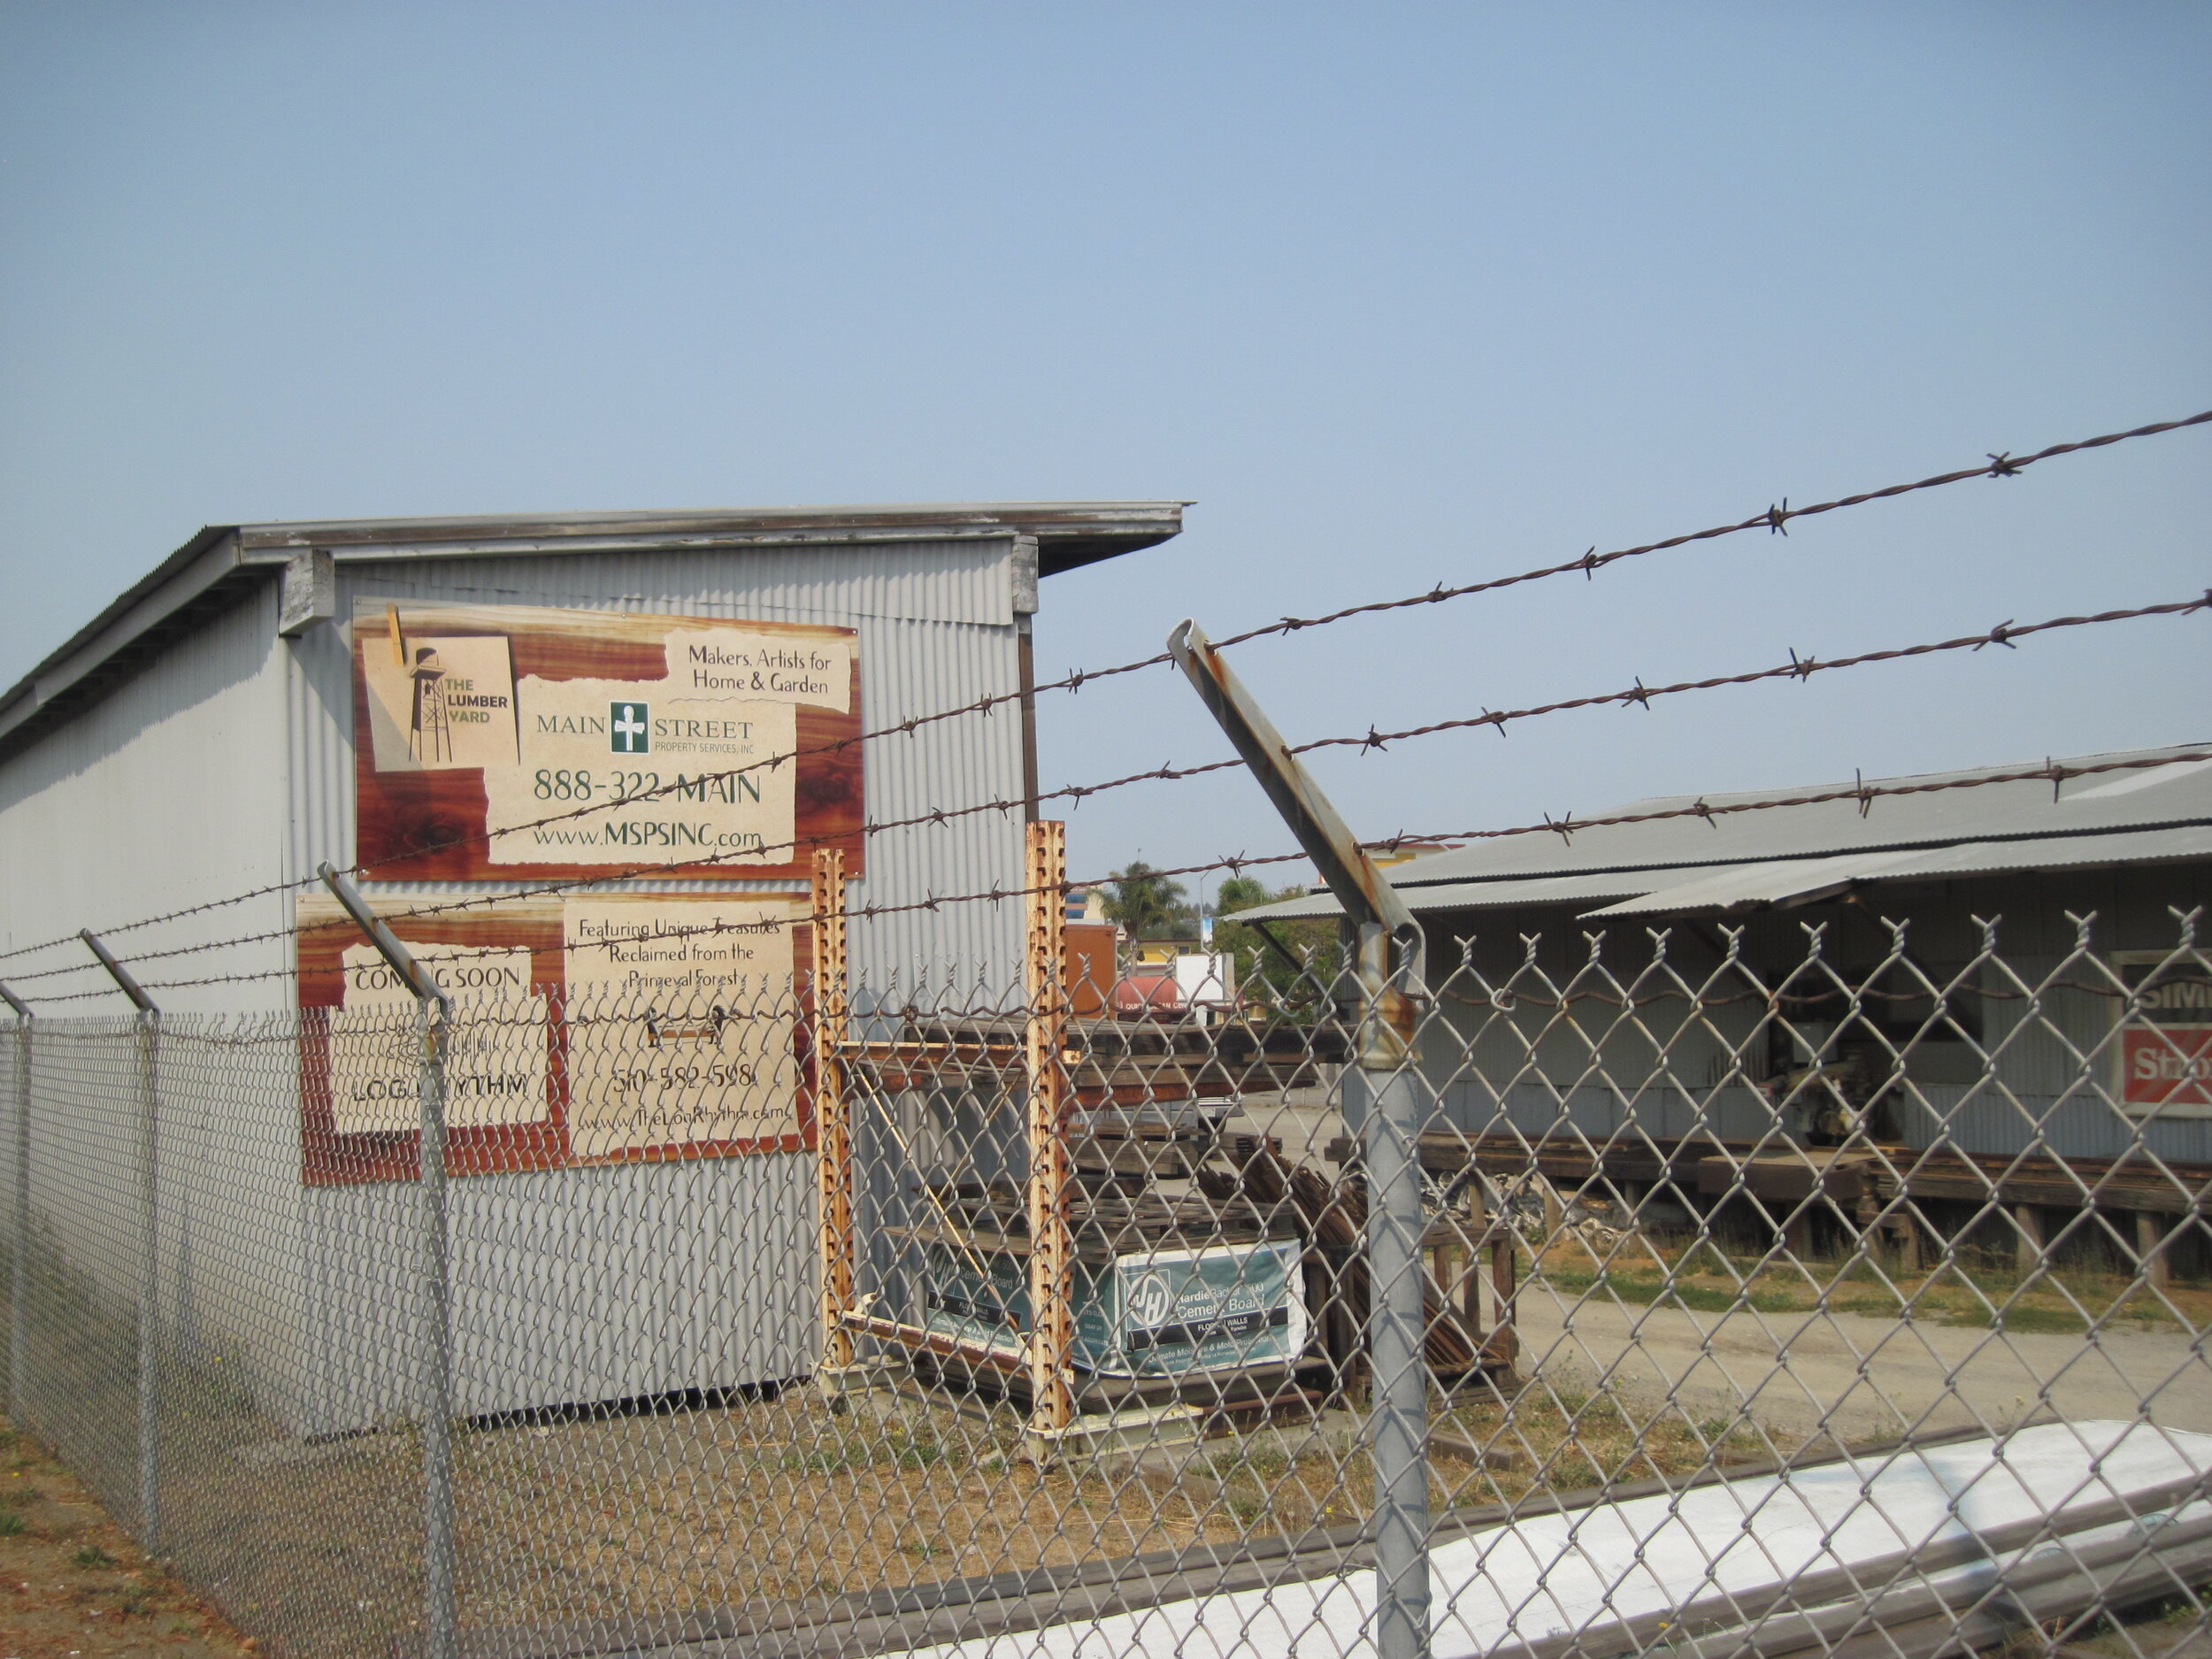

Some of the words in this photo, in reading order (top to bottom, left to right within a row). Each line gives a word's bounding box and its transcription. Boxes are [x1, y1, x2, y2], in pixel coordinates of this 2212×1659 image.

[689, 645, 752, 666] Makers,
[757, 649, 805, 670] Artists
[810, 651, 832, 671] for
[445, 679, 473, 690] THE
[694, 670, 745, 689] Home
[751, 672, 765, 690] &
[771, 672, 828, 693] Garden
[448, 695, 508, 708] LUMBER
[449, 710, 490, 723] YARD
[537, 715, 605, 734] MAIN
[655, 718, 754, 739] STREET
[655, 741, 697, 751] PROPERTY
[534, 822, 762, 846] www.MSPSINC.com
[580, 918, 649, 941] Featuring
[656, 918, 708, 941] Unique
[610, 943, 687, 963] Reclaimed
[692, 943, 726, 962] from
[733, 942, 754, 960] the
[456, 967, 520, 988] SOON
